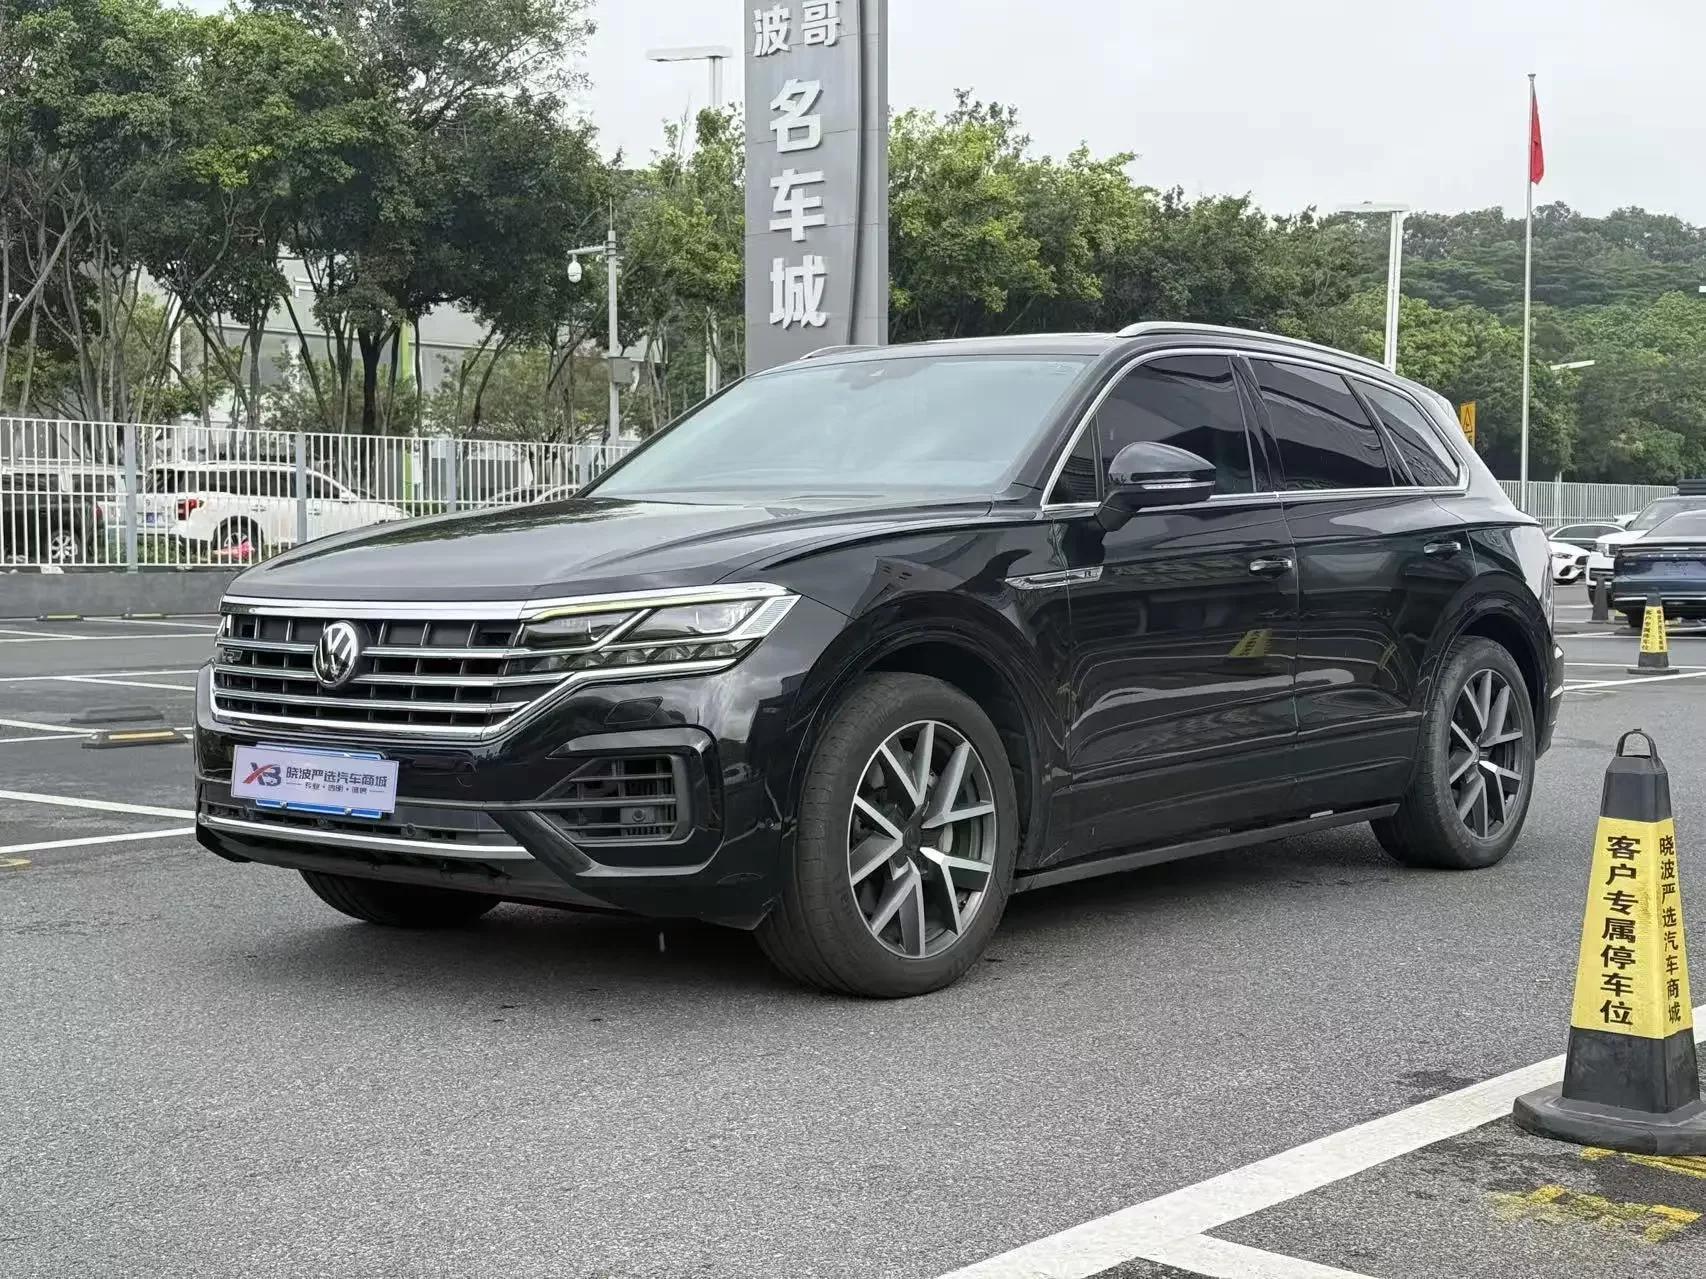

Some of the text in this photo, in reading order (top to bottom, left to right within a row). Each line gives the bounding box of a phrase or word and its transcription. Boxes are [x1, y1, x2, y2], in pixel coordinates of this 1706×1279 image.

[753, 0, 840, 57] 波哥
[769, 77, 827, 328] 名车城
[286, 766, 388, 788] 晓波严选汽车商城
[1600, 835, 1642, 1026] 客户专属停车位
[1659, 834, 1682, 1025] 晓波严选汽车商城
